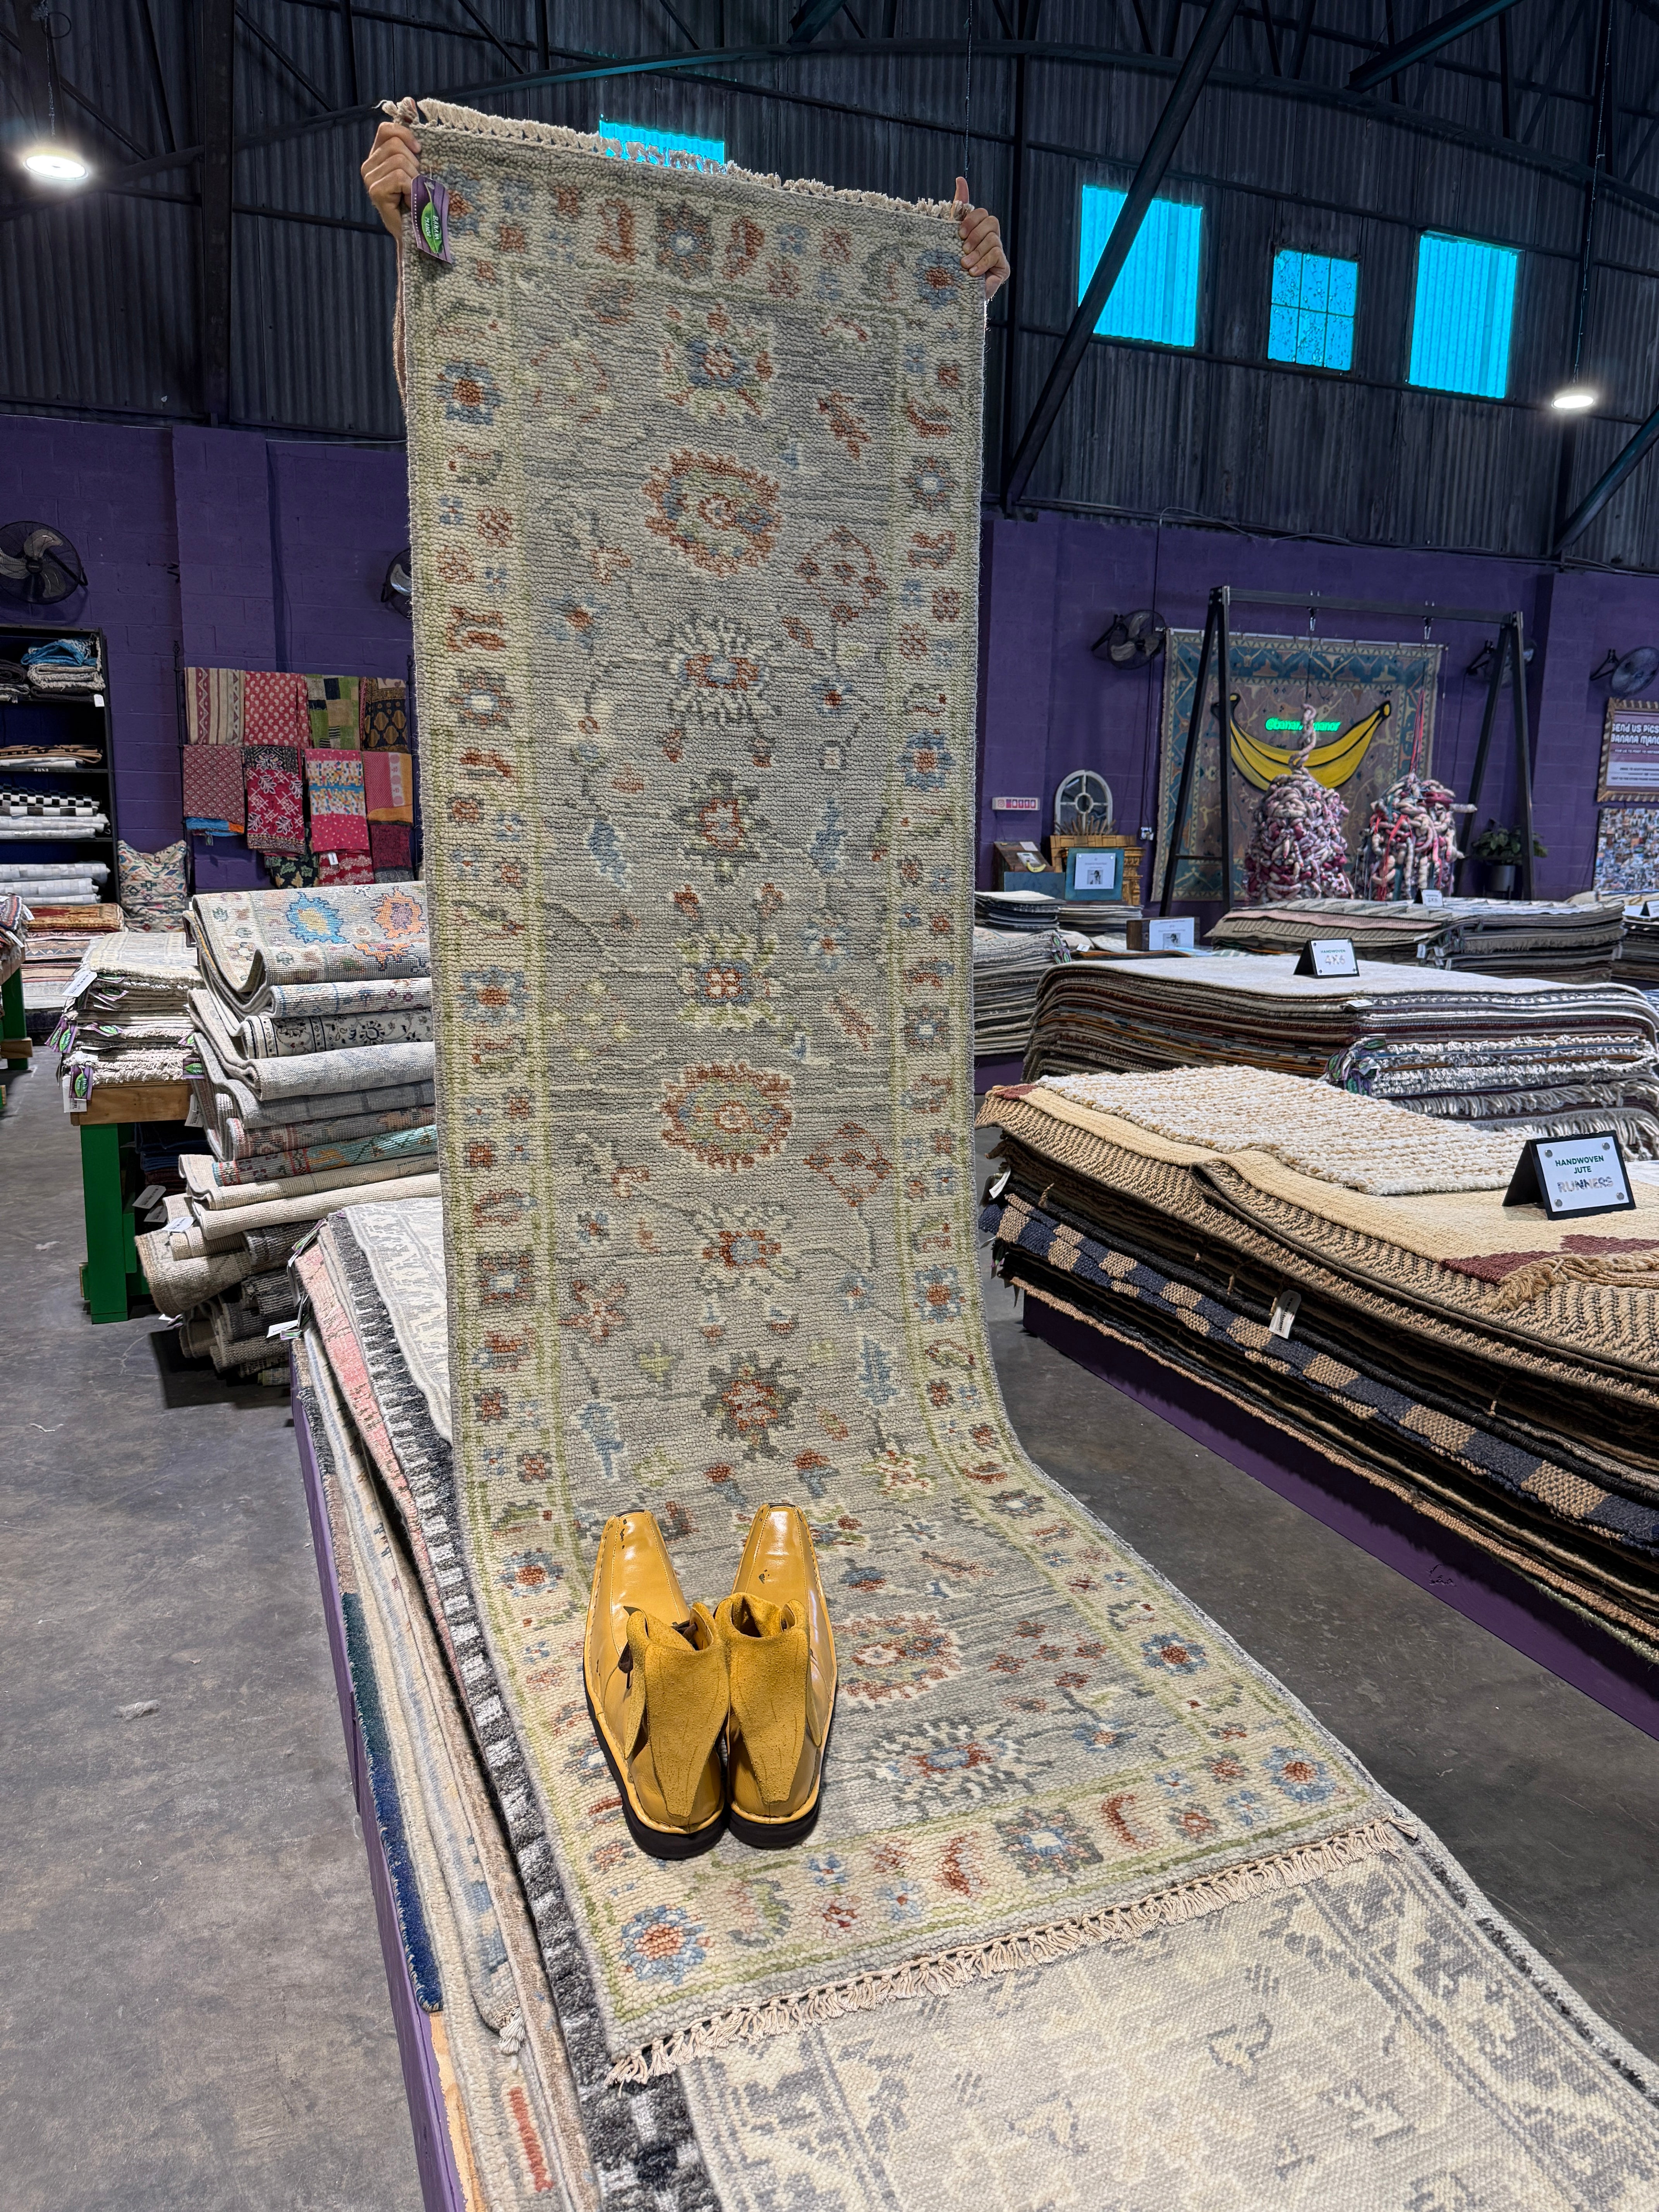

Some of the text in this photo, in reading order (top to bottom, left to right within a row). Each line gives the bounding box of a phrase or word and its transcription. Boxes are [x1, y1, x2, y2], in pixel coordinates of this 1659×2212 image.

[1632, 724, 1641, 733] US
[1555, 1155, 1604, 1166] HANDWOVEN
[1557, 1176, 1614, 1193] RUNNERS
